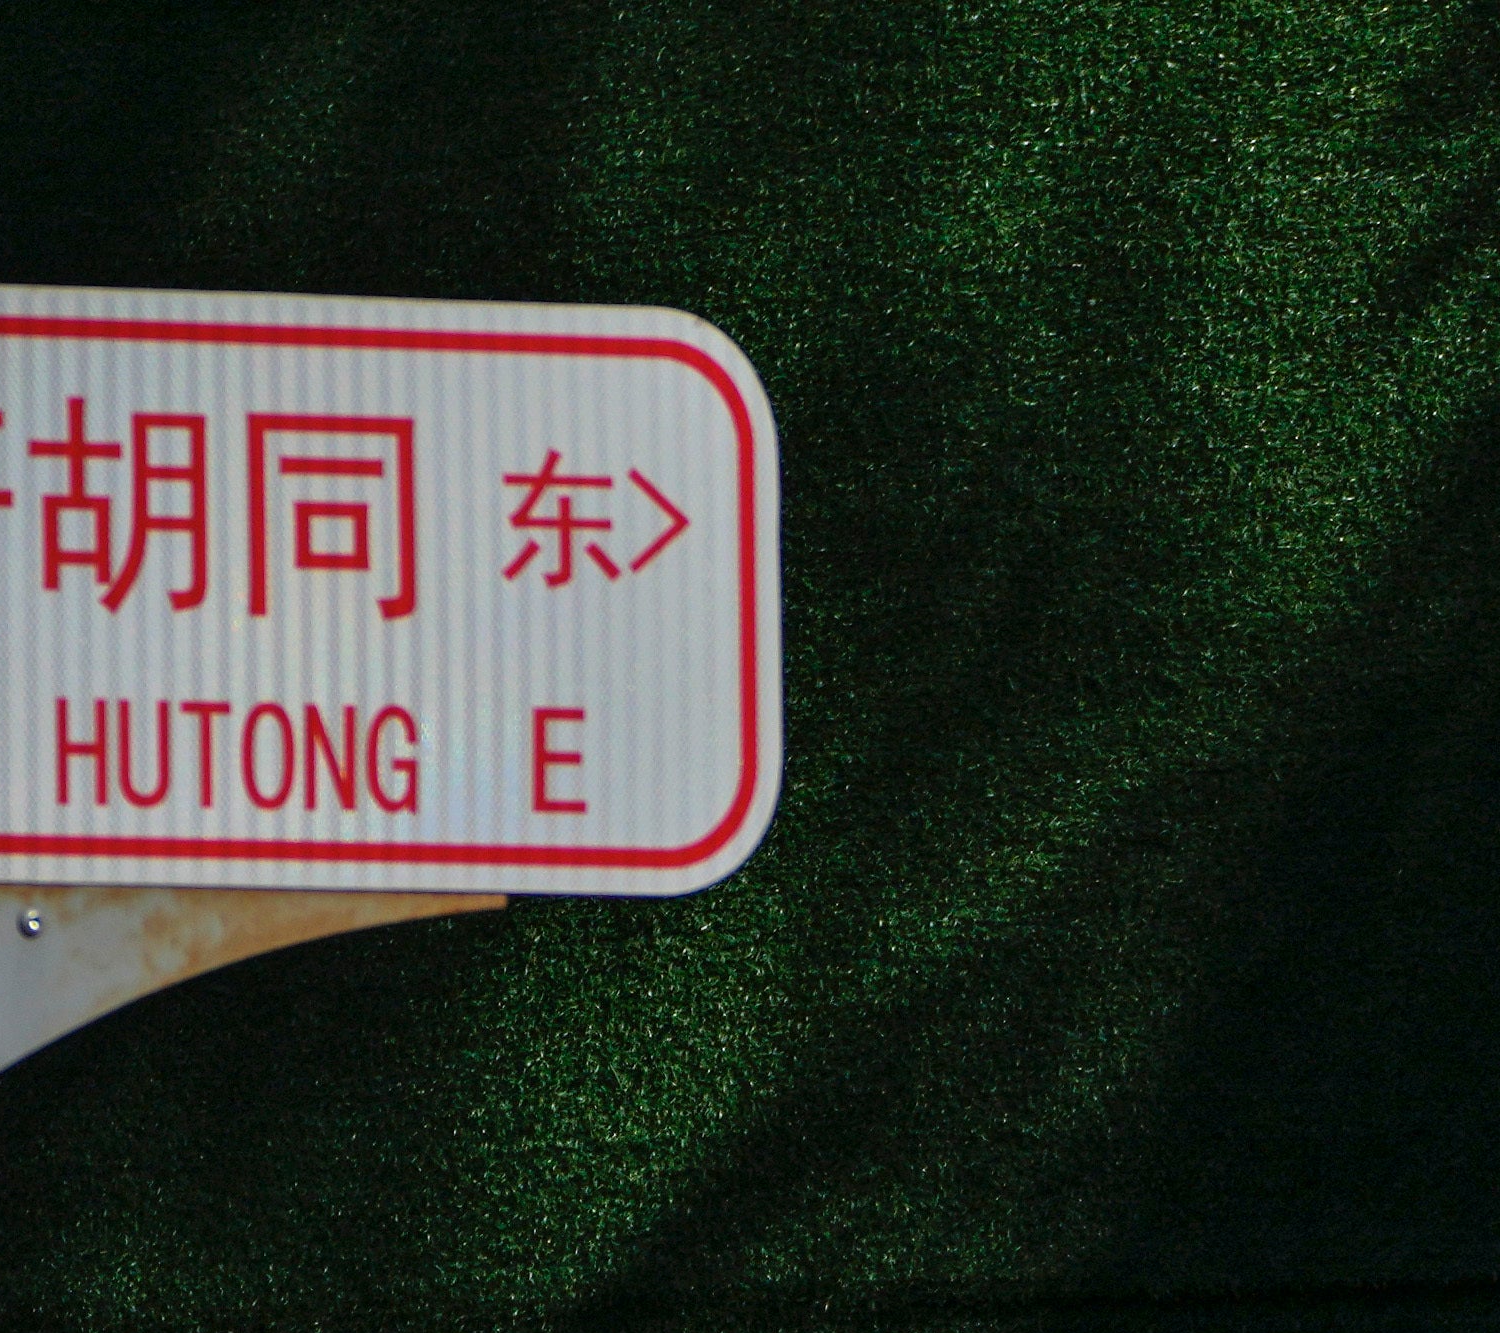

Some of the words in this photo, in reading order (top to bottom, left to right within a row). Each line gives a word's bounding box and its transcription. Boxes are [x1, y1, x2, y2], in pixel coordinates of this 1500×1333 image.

[503, 450, 620, 587] 东
[56, 698, 417, 813] HUTONG
[533, 707, 587, 813] E
